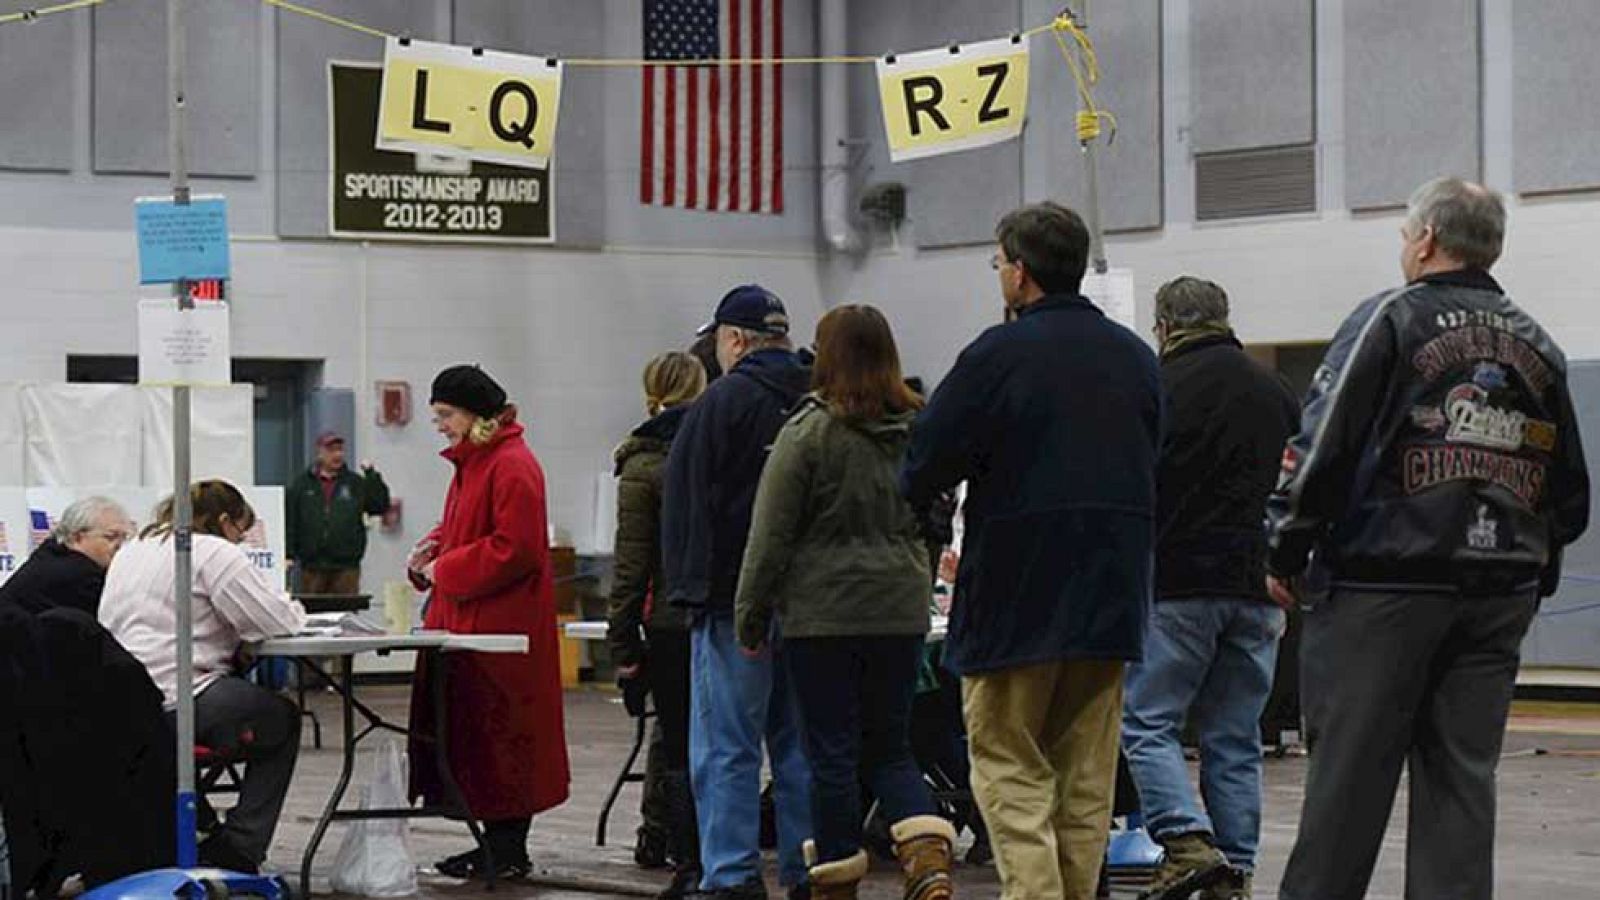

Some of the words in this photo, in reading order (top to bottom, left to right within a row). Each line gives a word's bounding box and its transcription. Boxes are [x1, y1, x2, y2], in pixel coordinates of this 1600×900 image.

[412, 69, 451, 133] L
[489, 80, 538, 150] Q
[902, 76, 951, 136] R
[977, 62, 1010, 123] Z
[345, 173, 482, 201] SPORTSMANSHIP
[487, 178, 540, 202] AWARD
[383, 203, 502, 230] 2012-2013
[246, 551, 276, 569] OTE
